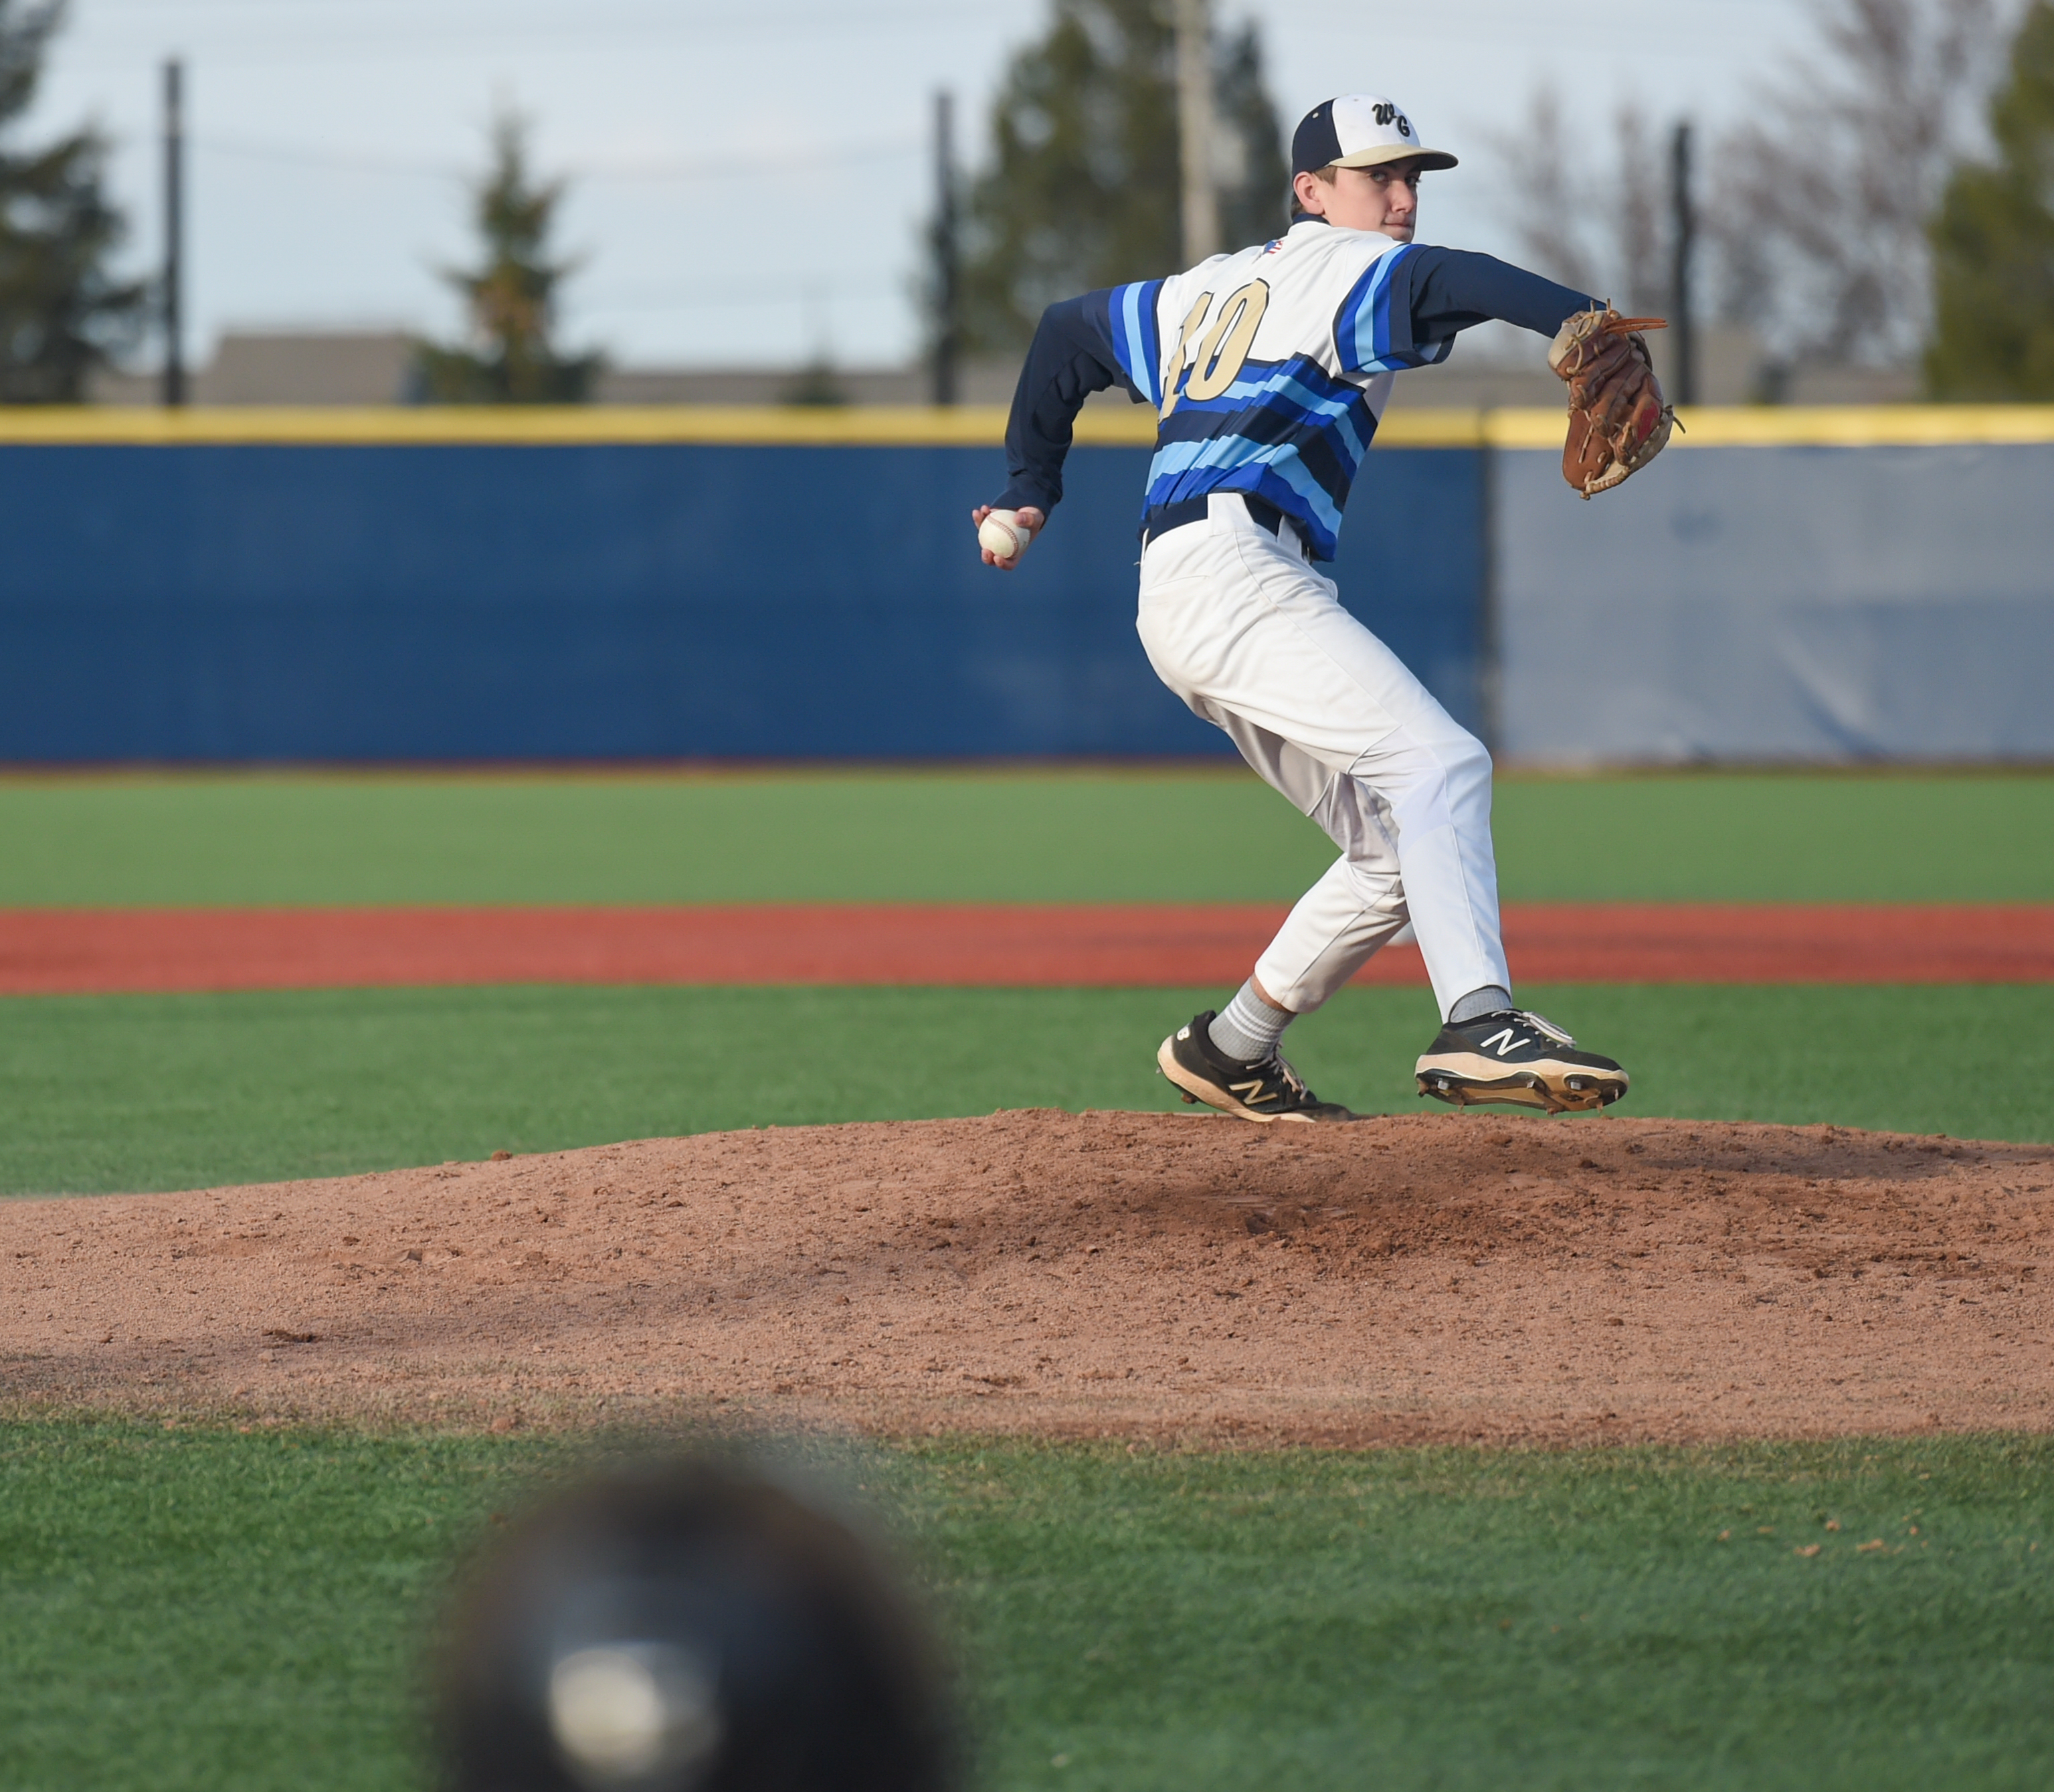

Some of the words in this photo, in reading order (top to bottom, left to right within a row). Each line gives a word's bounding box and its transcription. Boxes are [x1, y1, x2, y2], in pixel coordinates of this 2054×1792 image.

[1158, 277, 1270, 424] 10
[1480, 1028, 1531, 1056] N
[1228, 1079, 1278, 1104] N
